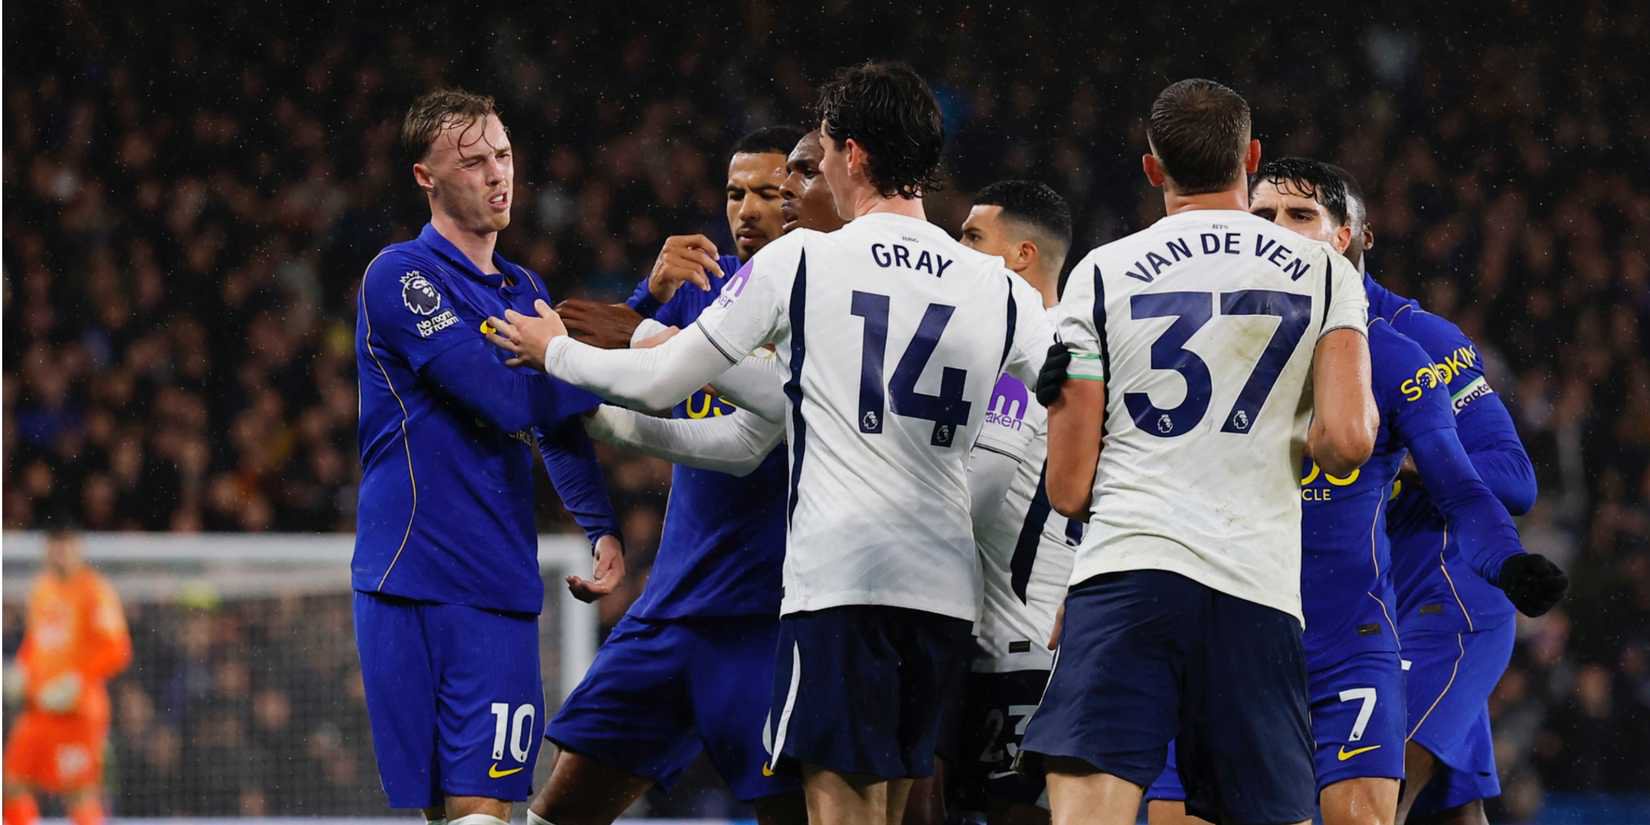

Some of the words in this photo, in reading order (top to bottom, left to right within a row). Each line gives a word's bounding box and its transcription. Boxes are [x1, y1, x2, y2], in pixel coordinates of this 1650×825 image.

[871, 243, 953, 278] GRAY
[1125, 238, 1193, 283] VAN
[1200, 233, 1241, 255] DE
[1255, 234, 1311, 282] VEN
[851, 290, 971, 448] 14
[1123, 290, 1312, 438] 37
[491, 703, 536, 763] 10
[1339, 687, 1377, 742] 7
